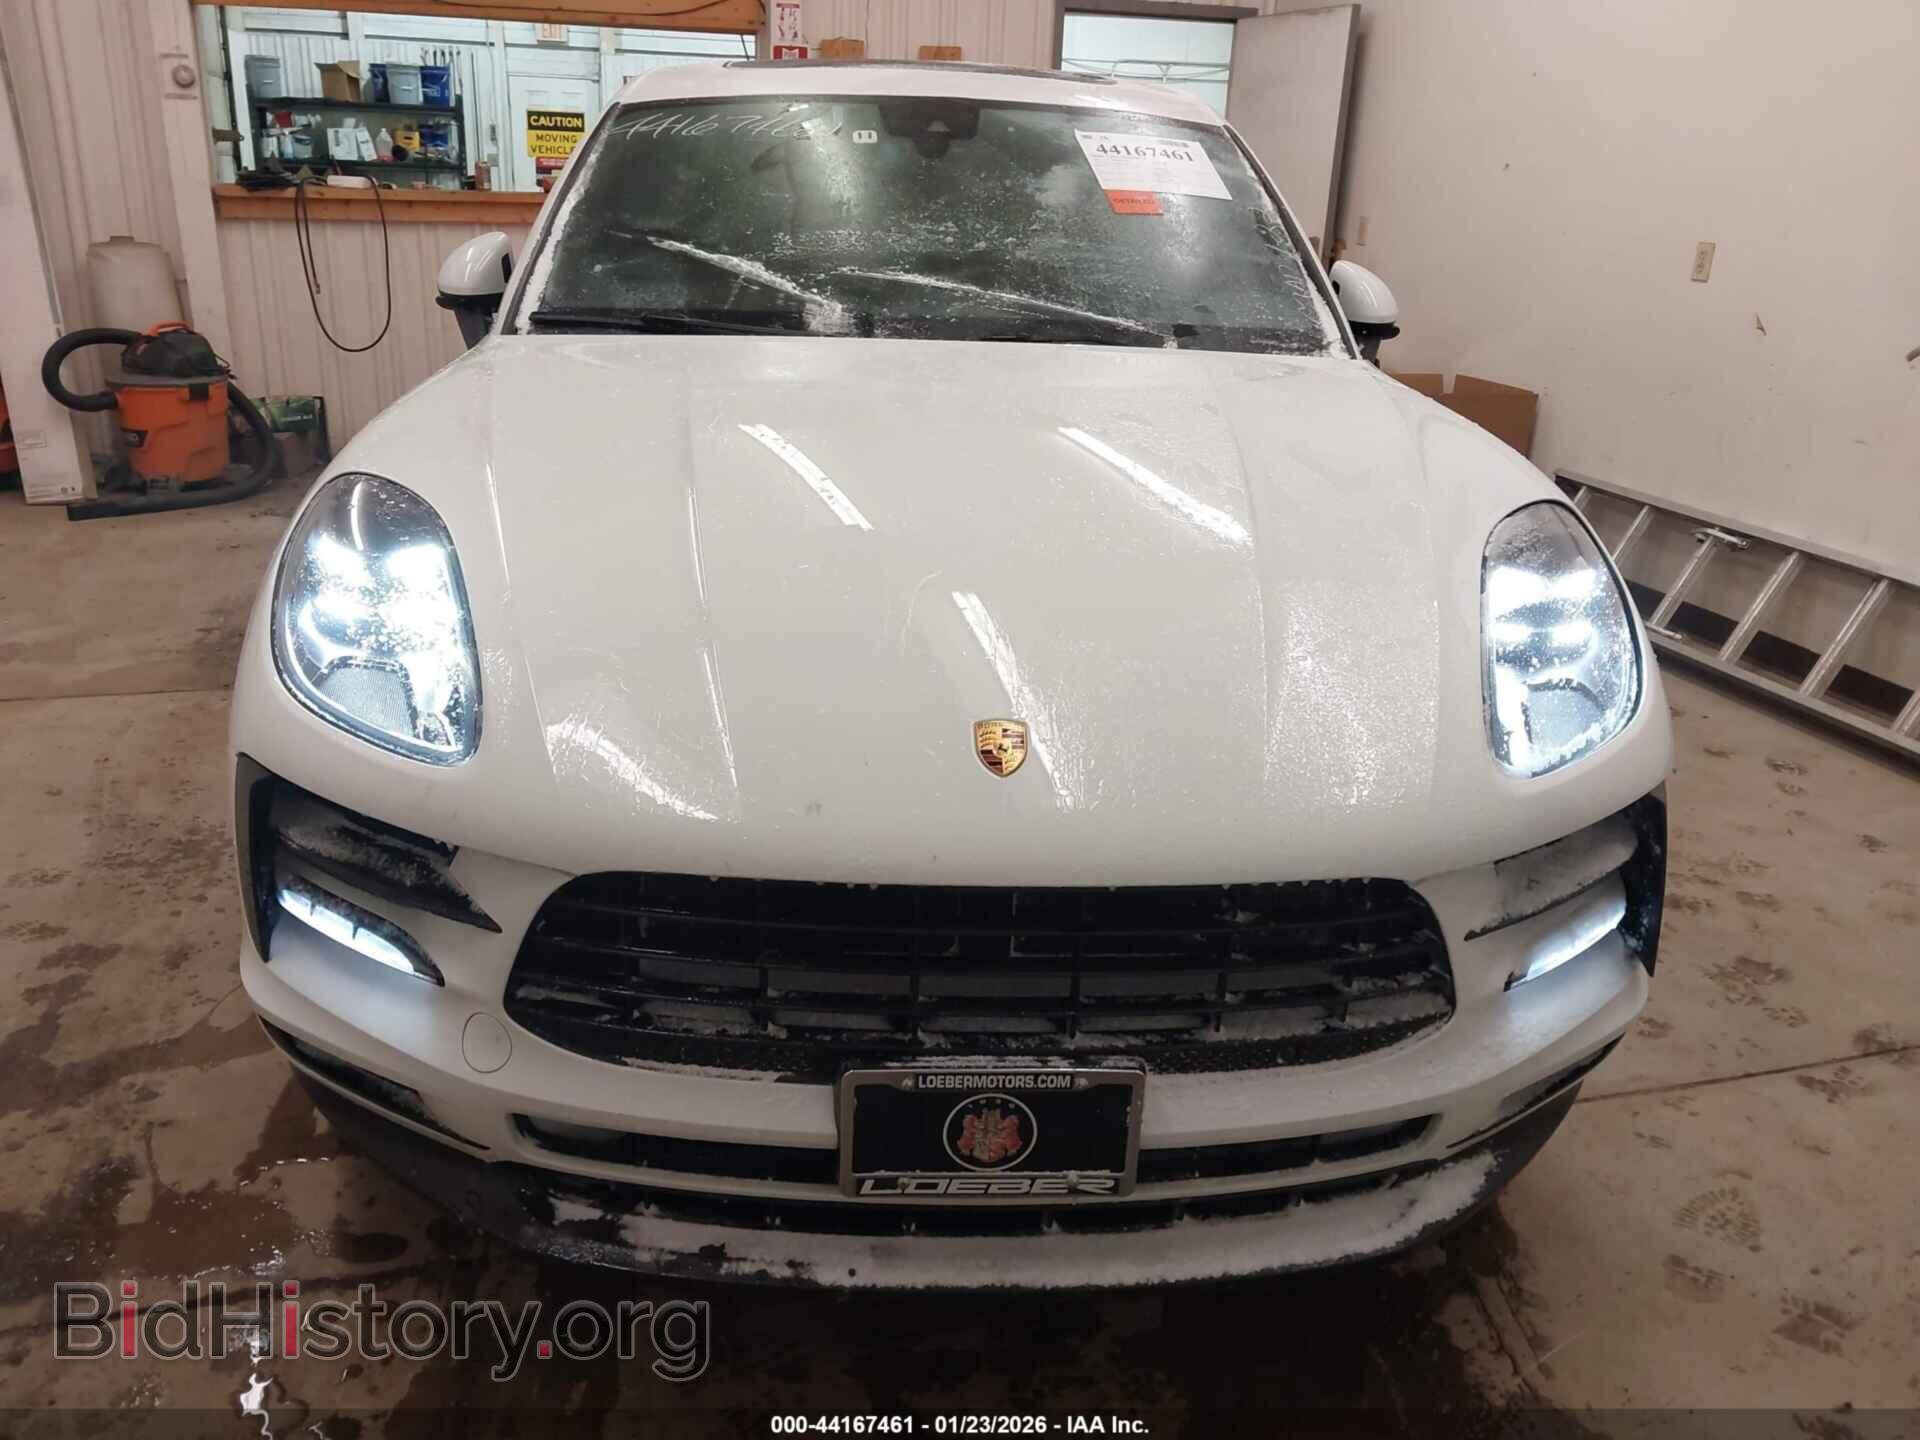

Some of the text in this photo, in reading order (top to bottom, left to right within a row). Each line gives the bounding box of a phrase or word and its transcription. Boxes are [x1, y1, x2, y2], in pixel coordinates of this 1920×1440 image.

[530, 115, 583, 128] CAUTION
[535, 133, 577, 144] MOVING
[1096, 144, 1195, 162] 44167461
[918, 1074, 1072, 1089] LOEBERMOTORS.COM
[859, 1177, 1116, 1196] LOEBER
